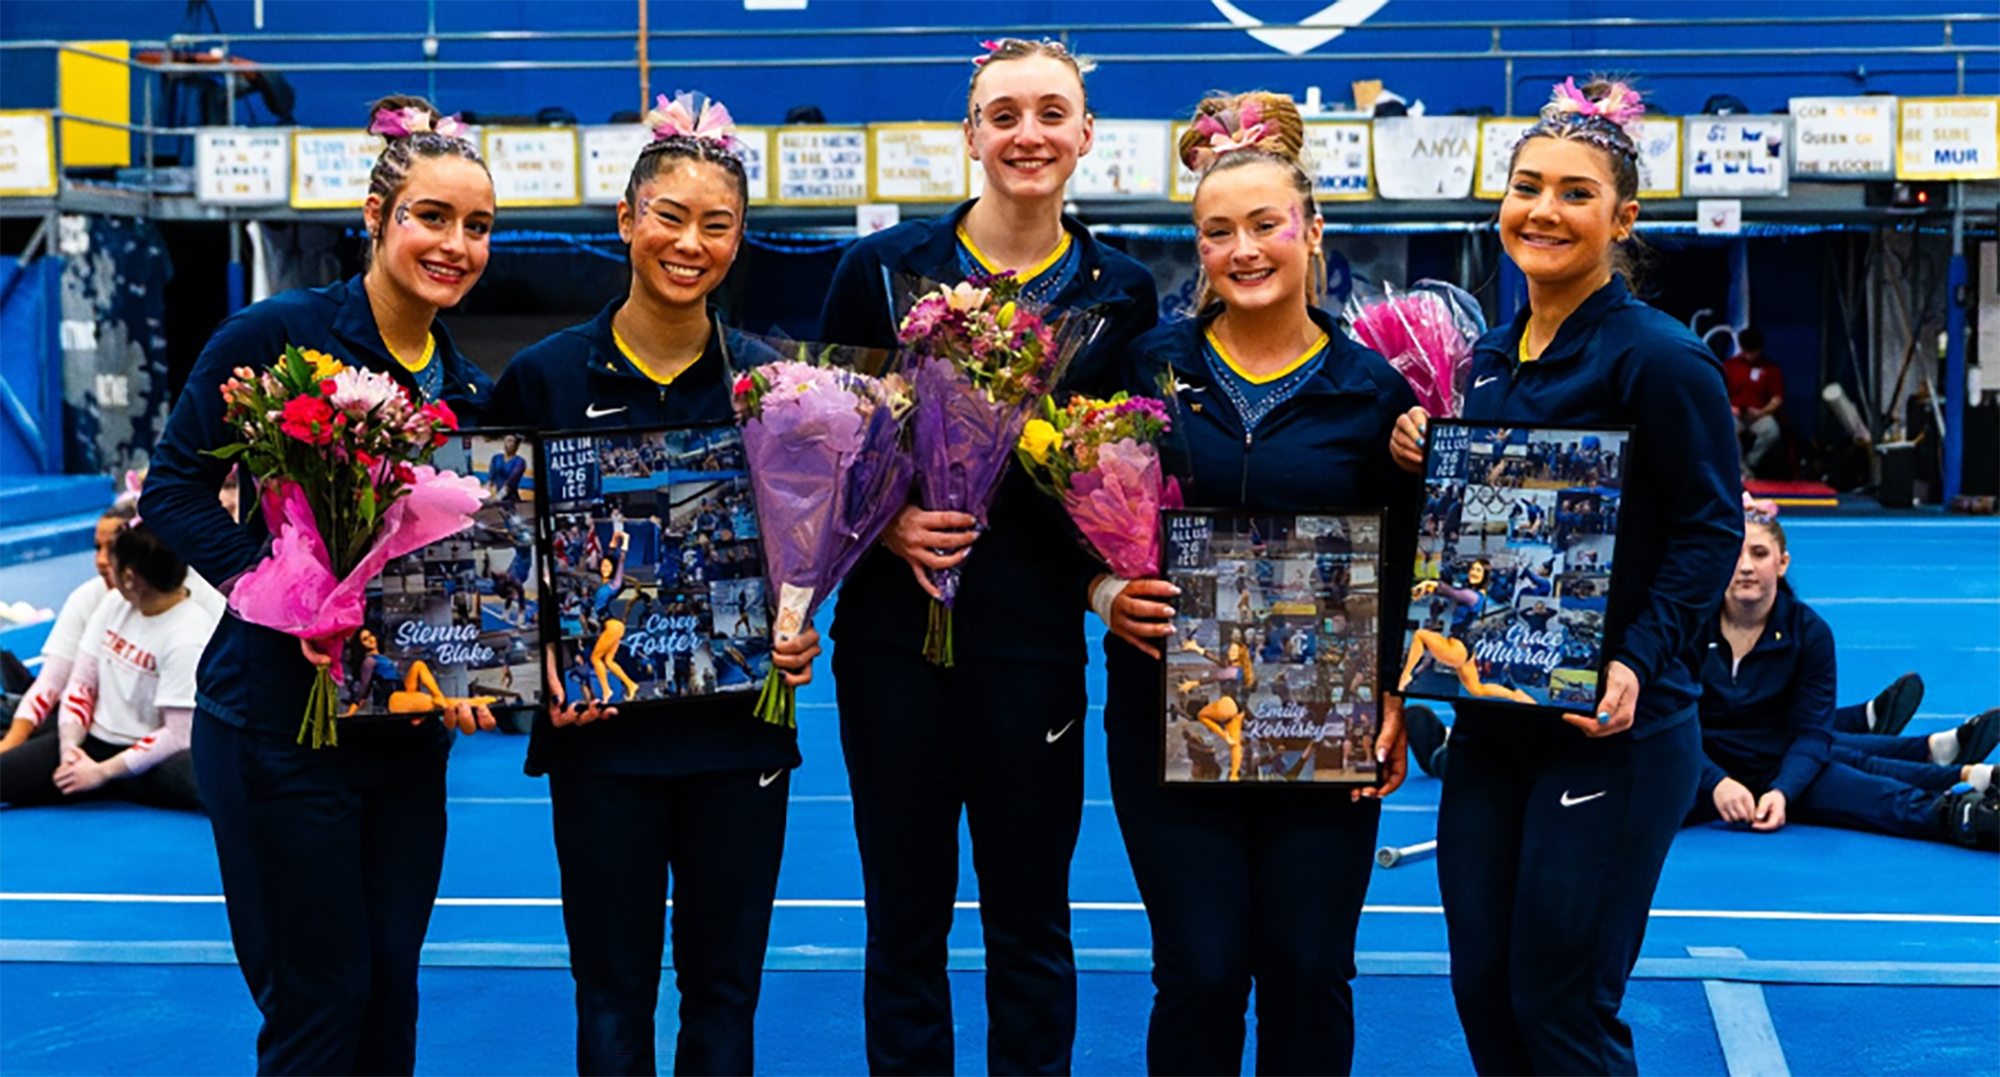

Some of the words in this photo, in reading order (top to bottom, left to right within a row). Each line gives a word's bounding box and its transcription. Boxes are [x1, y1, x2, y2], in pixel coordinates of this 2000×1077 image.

[1905, 107, 1922, 119] BE
[1933, 106, 1989, 118] STRONG
[1802, 131, 1847, 145] QUEEN
[1905, 128, 1922, 142] BE
[1933, 127, 1970, 141] SURE
[1411, 137, 1472, 158] ANYA
[1934, 149, 1979, 165] MUR
[1798, 161, 1820, 173] THE
[550, 439, 576, 454] ALL
[577, 436, 592, 450] IN
[550, 454, 577, 470] ALL
[576, 450, 596, 466] US
[560, 467, 587, 485] '26
[1170, 530, 1192, 541] ALL
[395, 620, 480, 646] Sienna
[646, 613, 699, 635] Corey
[626, 631, 704, 658] Foster
[1506, 623, 1564, 646] Grace
[436, 642, 495, 666] Blake
[1475, 637, 1563, 674] Murray
[1257, 701, 1309, 724] Emily
